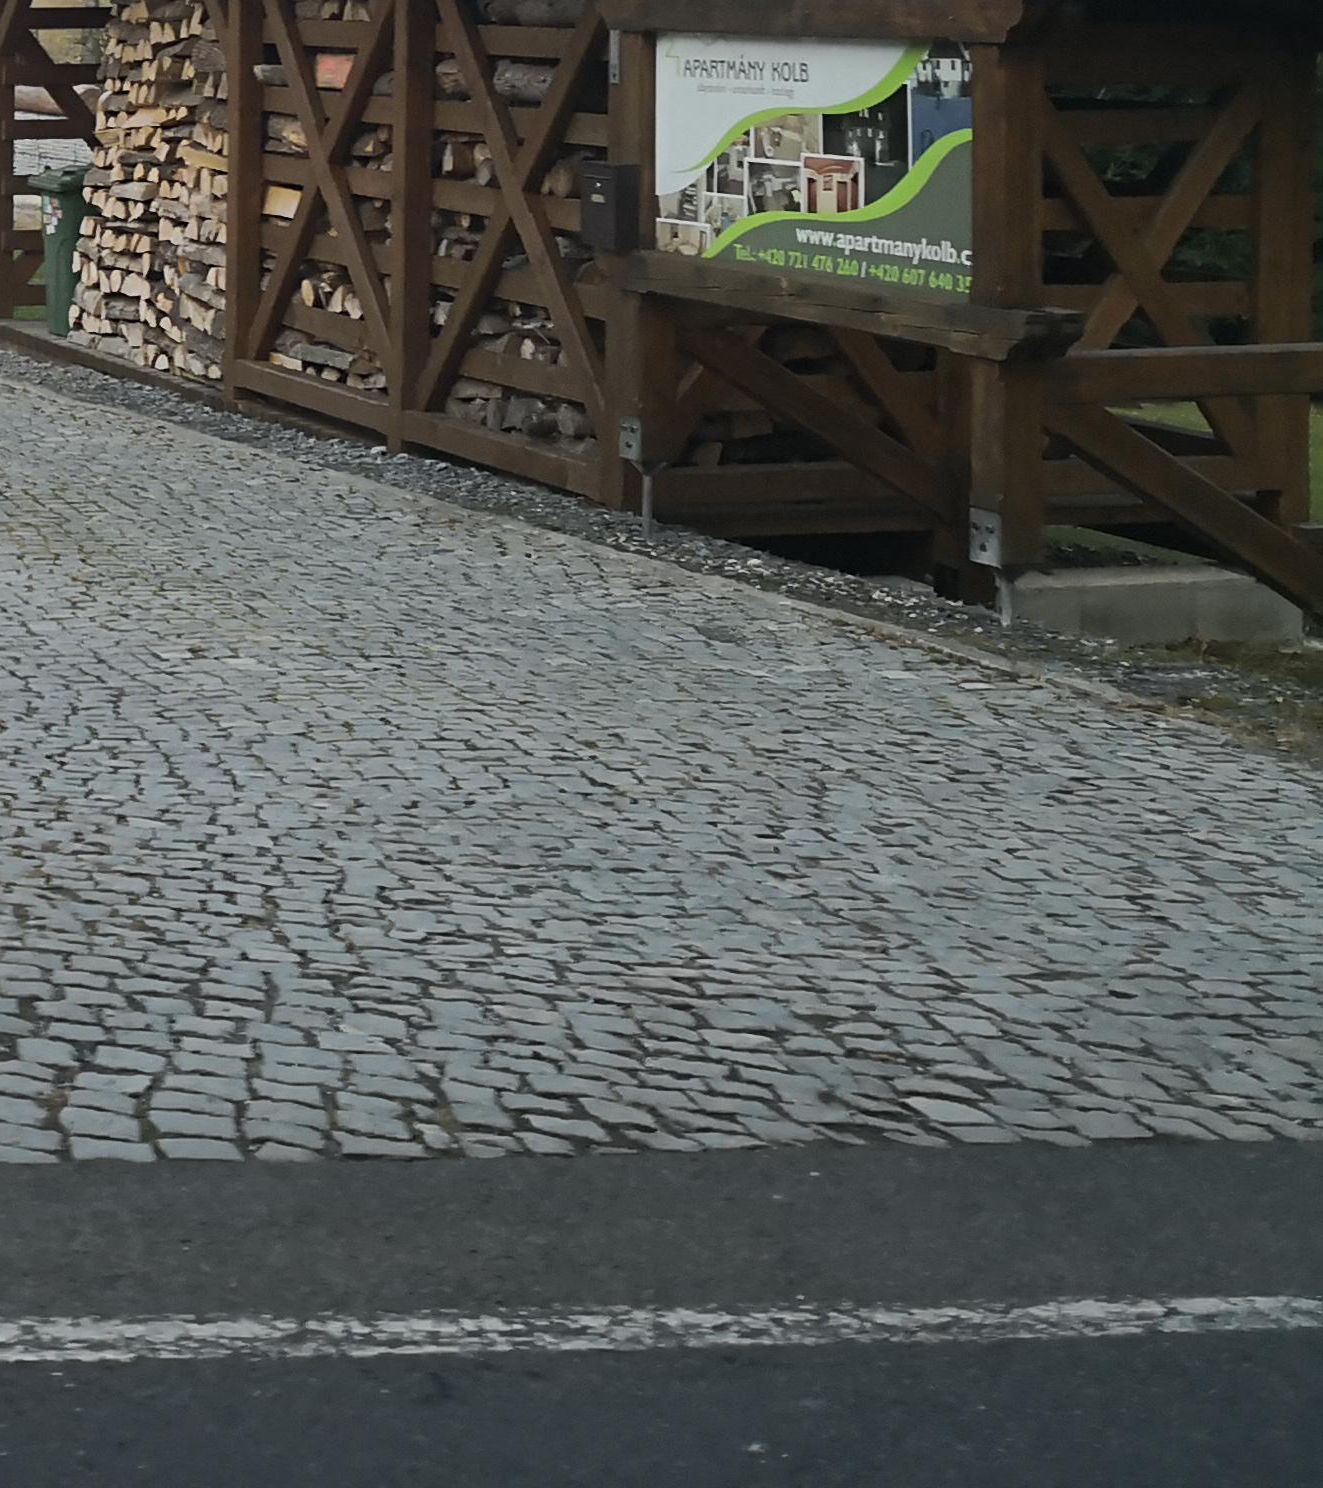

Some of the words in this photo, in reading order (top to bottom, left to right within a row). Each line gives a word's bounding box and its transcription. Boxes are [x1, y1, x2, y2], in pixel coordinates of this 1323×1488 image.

[683, 54, 765, 81] APARTMÁNY
[771, 61, 810, 83] KOLB
[811, 254, 834, 273] 476
